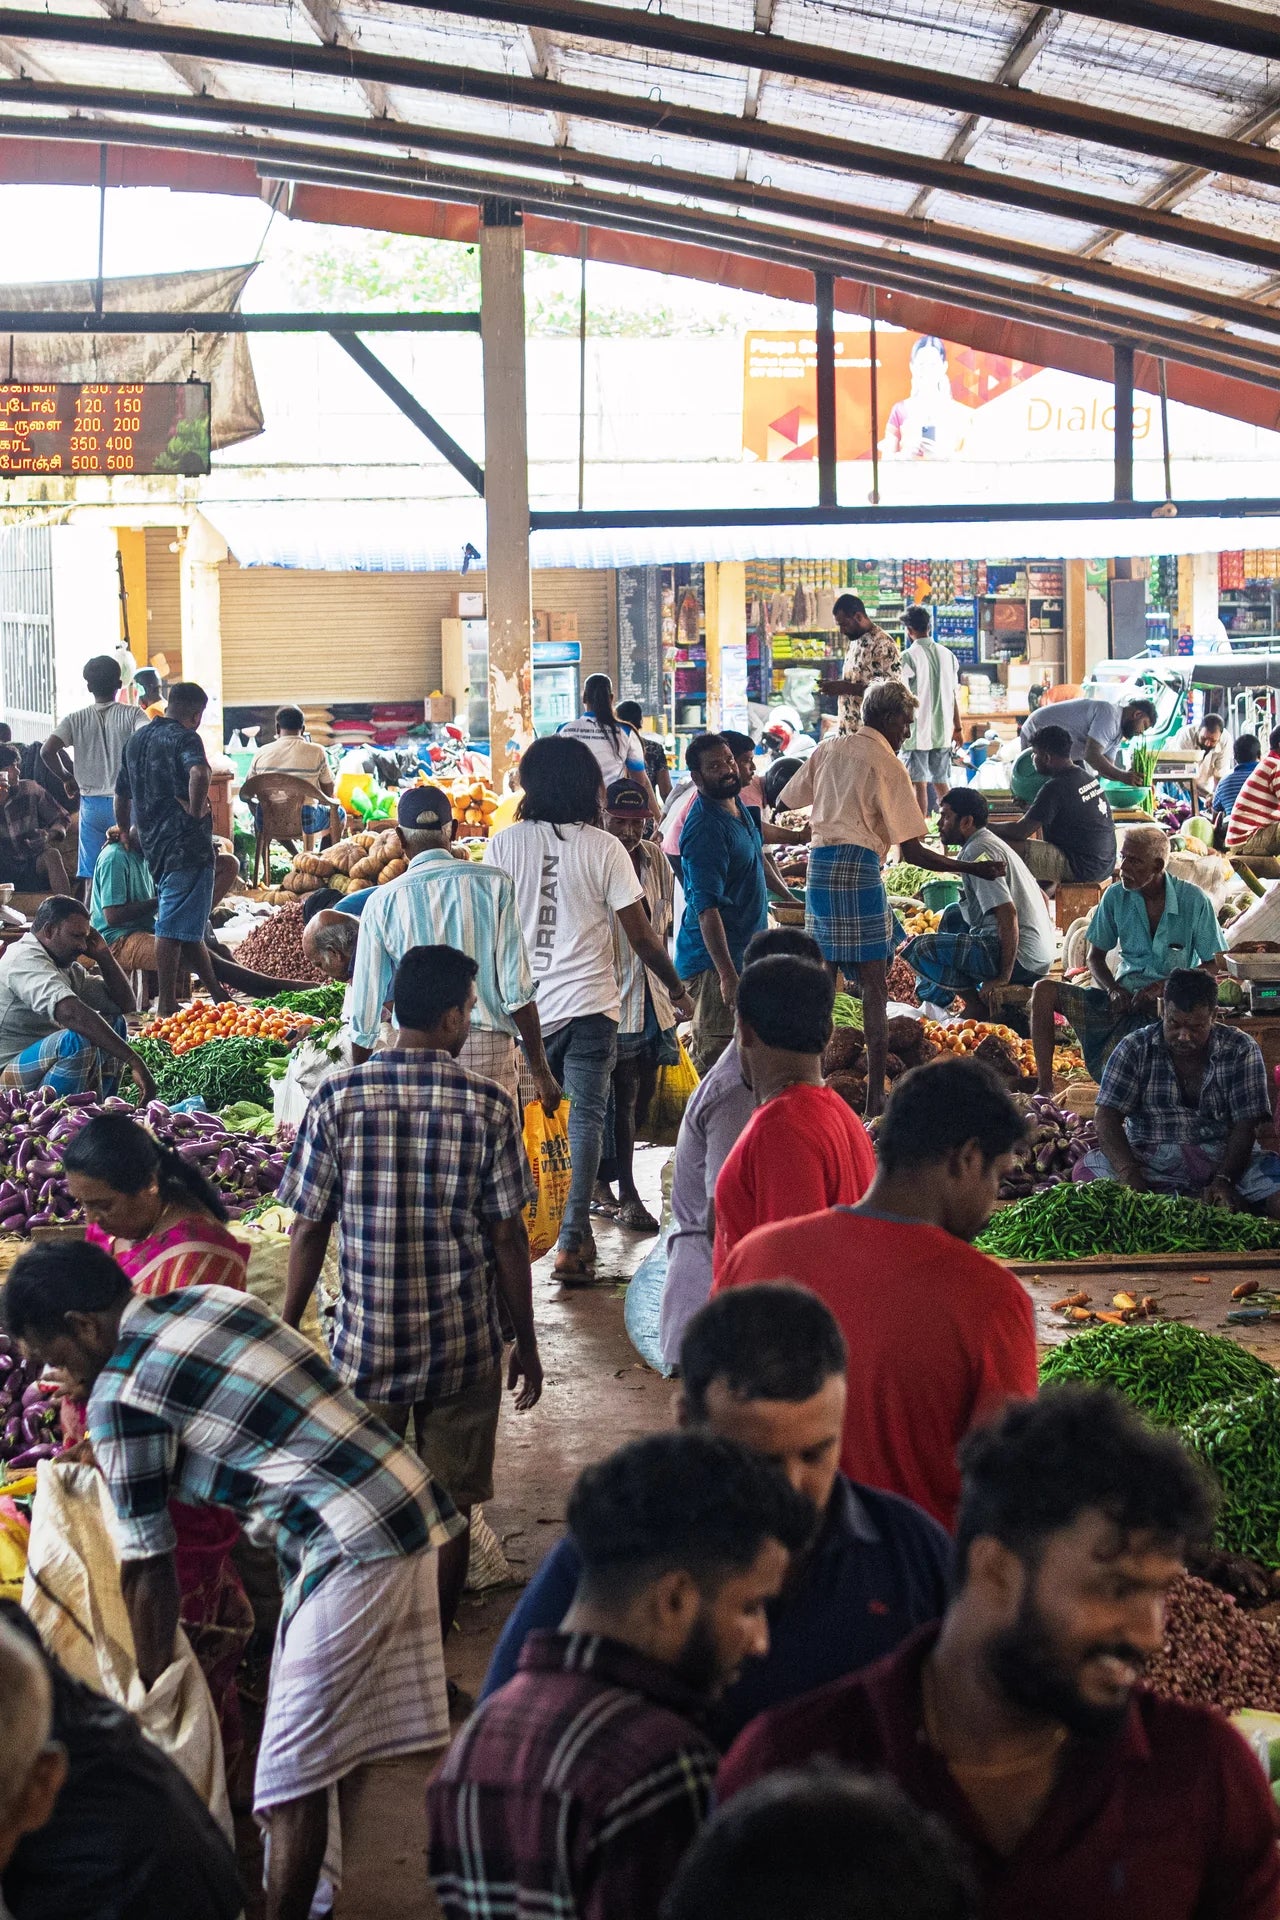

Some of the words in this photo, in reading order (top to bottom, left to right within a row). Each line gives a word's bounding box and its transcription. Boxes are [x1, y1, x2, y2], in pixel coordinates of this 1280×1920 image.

[75, 398, 106, 413] 120.
[114, 398, 141, 413] 150
[73, 417, 105, 432] 200.
[113, 417, 140, 432] 200
[70, 436, 101, 451] 350.
[105, 436, 133, 451] 400
[71, 455, 102, 470] 500.
[107, 455, 134, 470] 500
[532, 854, 560, 972] URBAN
